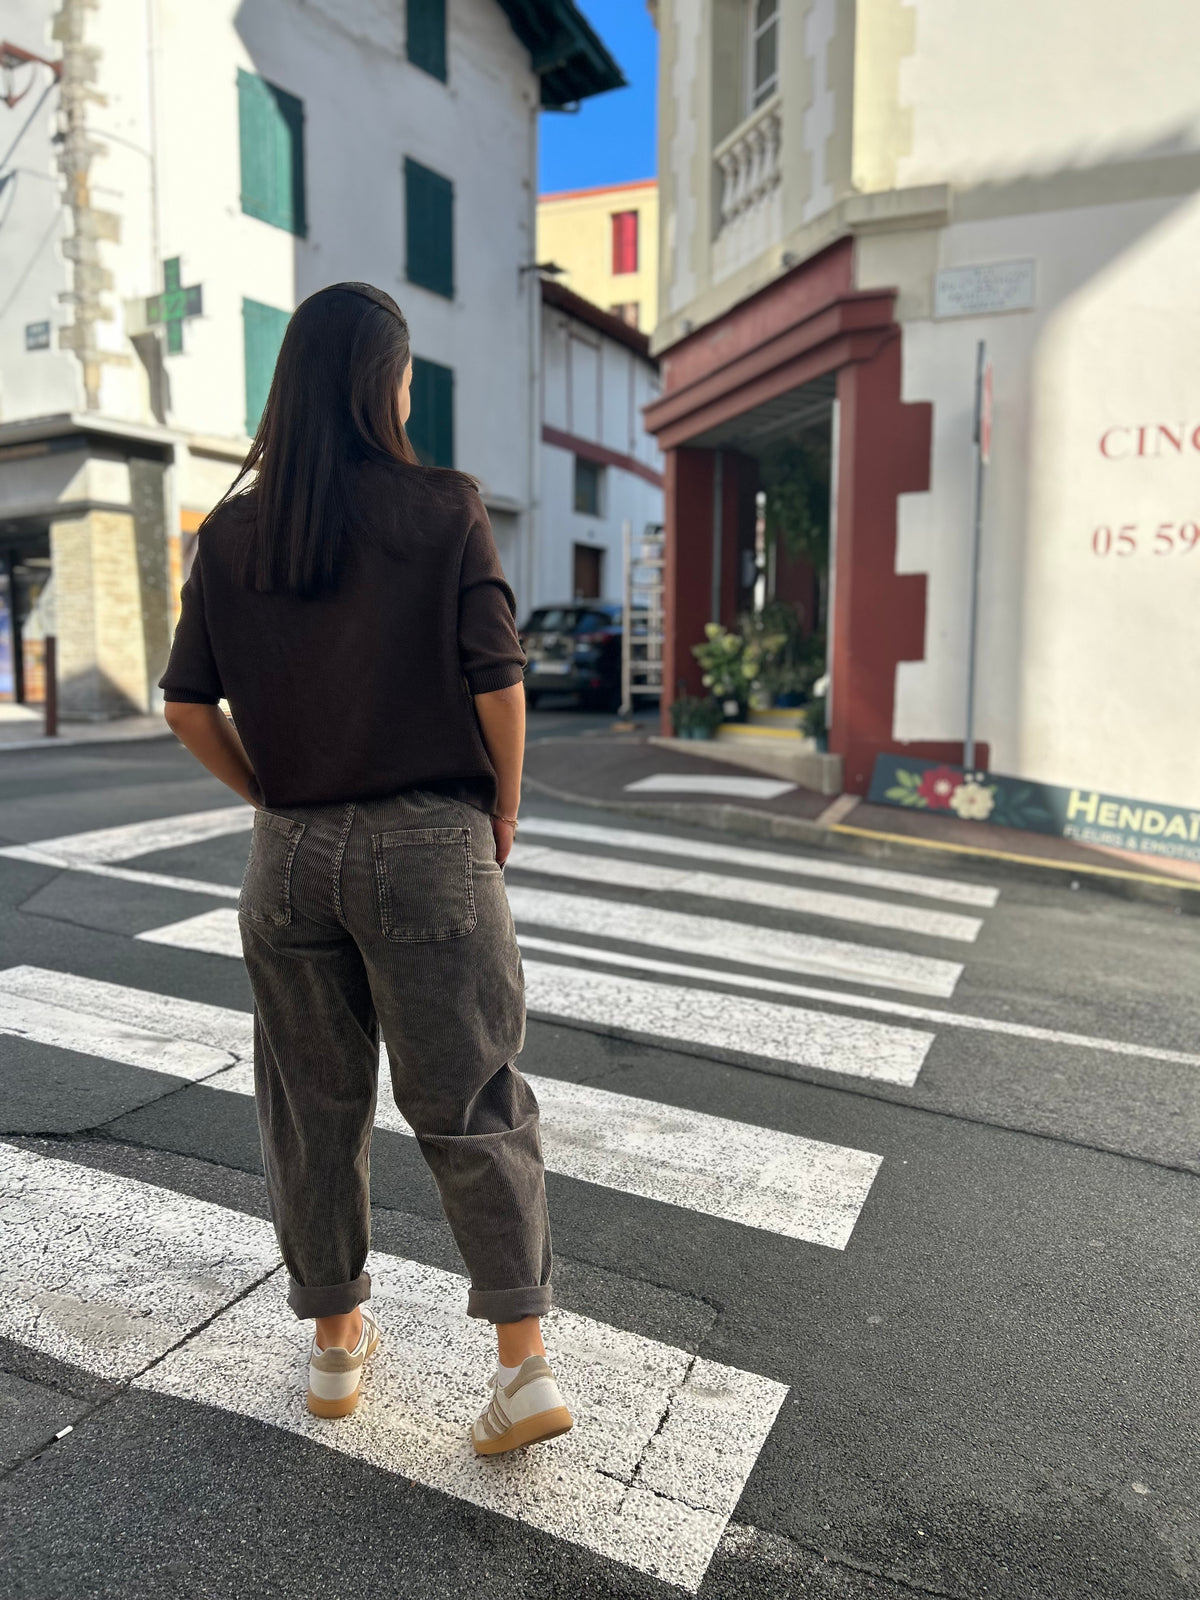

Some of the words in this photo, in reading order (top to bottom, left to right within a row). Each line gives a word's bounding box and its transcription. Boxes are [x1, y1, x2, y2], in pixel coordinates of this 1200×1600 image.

[1099, 424, 1200, 459] CIN
[1092, 523, 1137, 557] 05
[1153, 521, 1200, 555] 59
[1062, 824, 1123, 848] FLEURS
[1125, 836, 1138, 850] &
